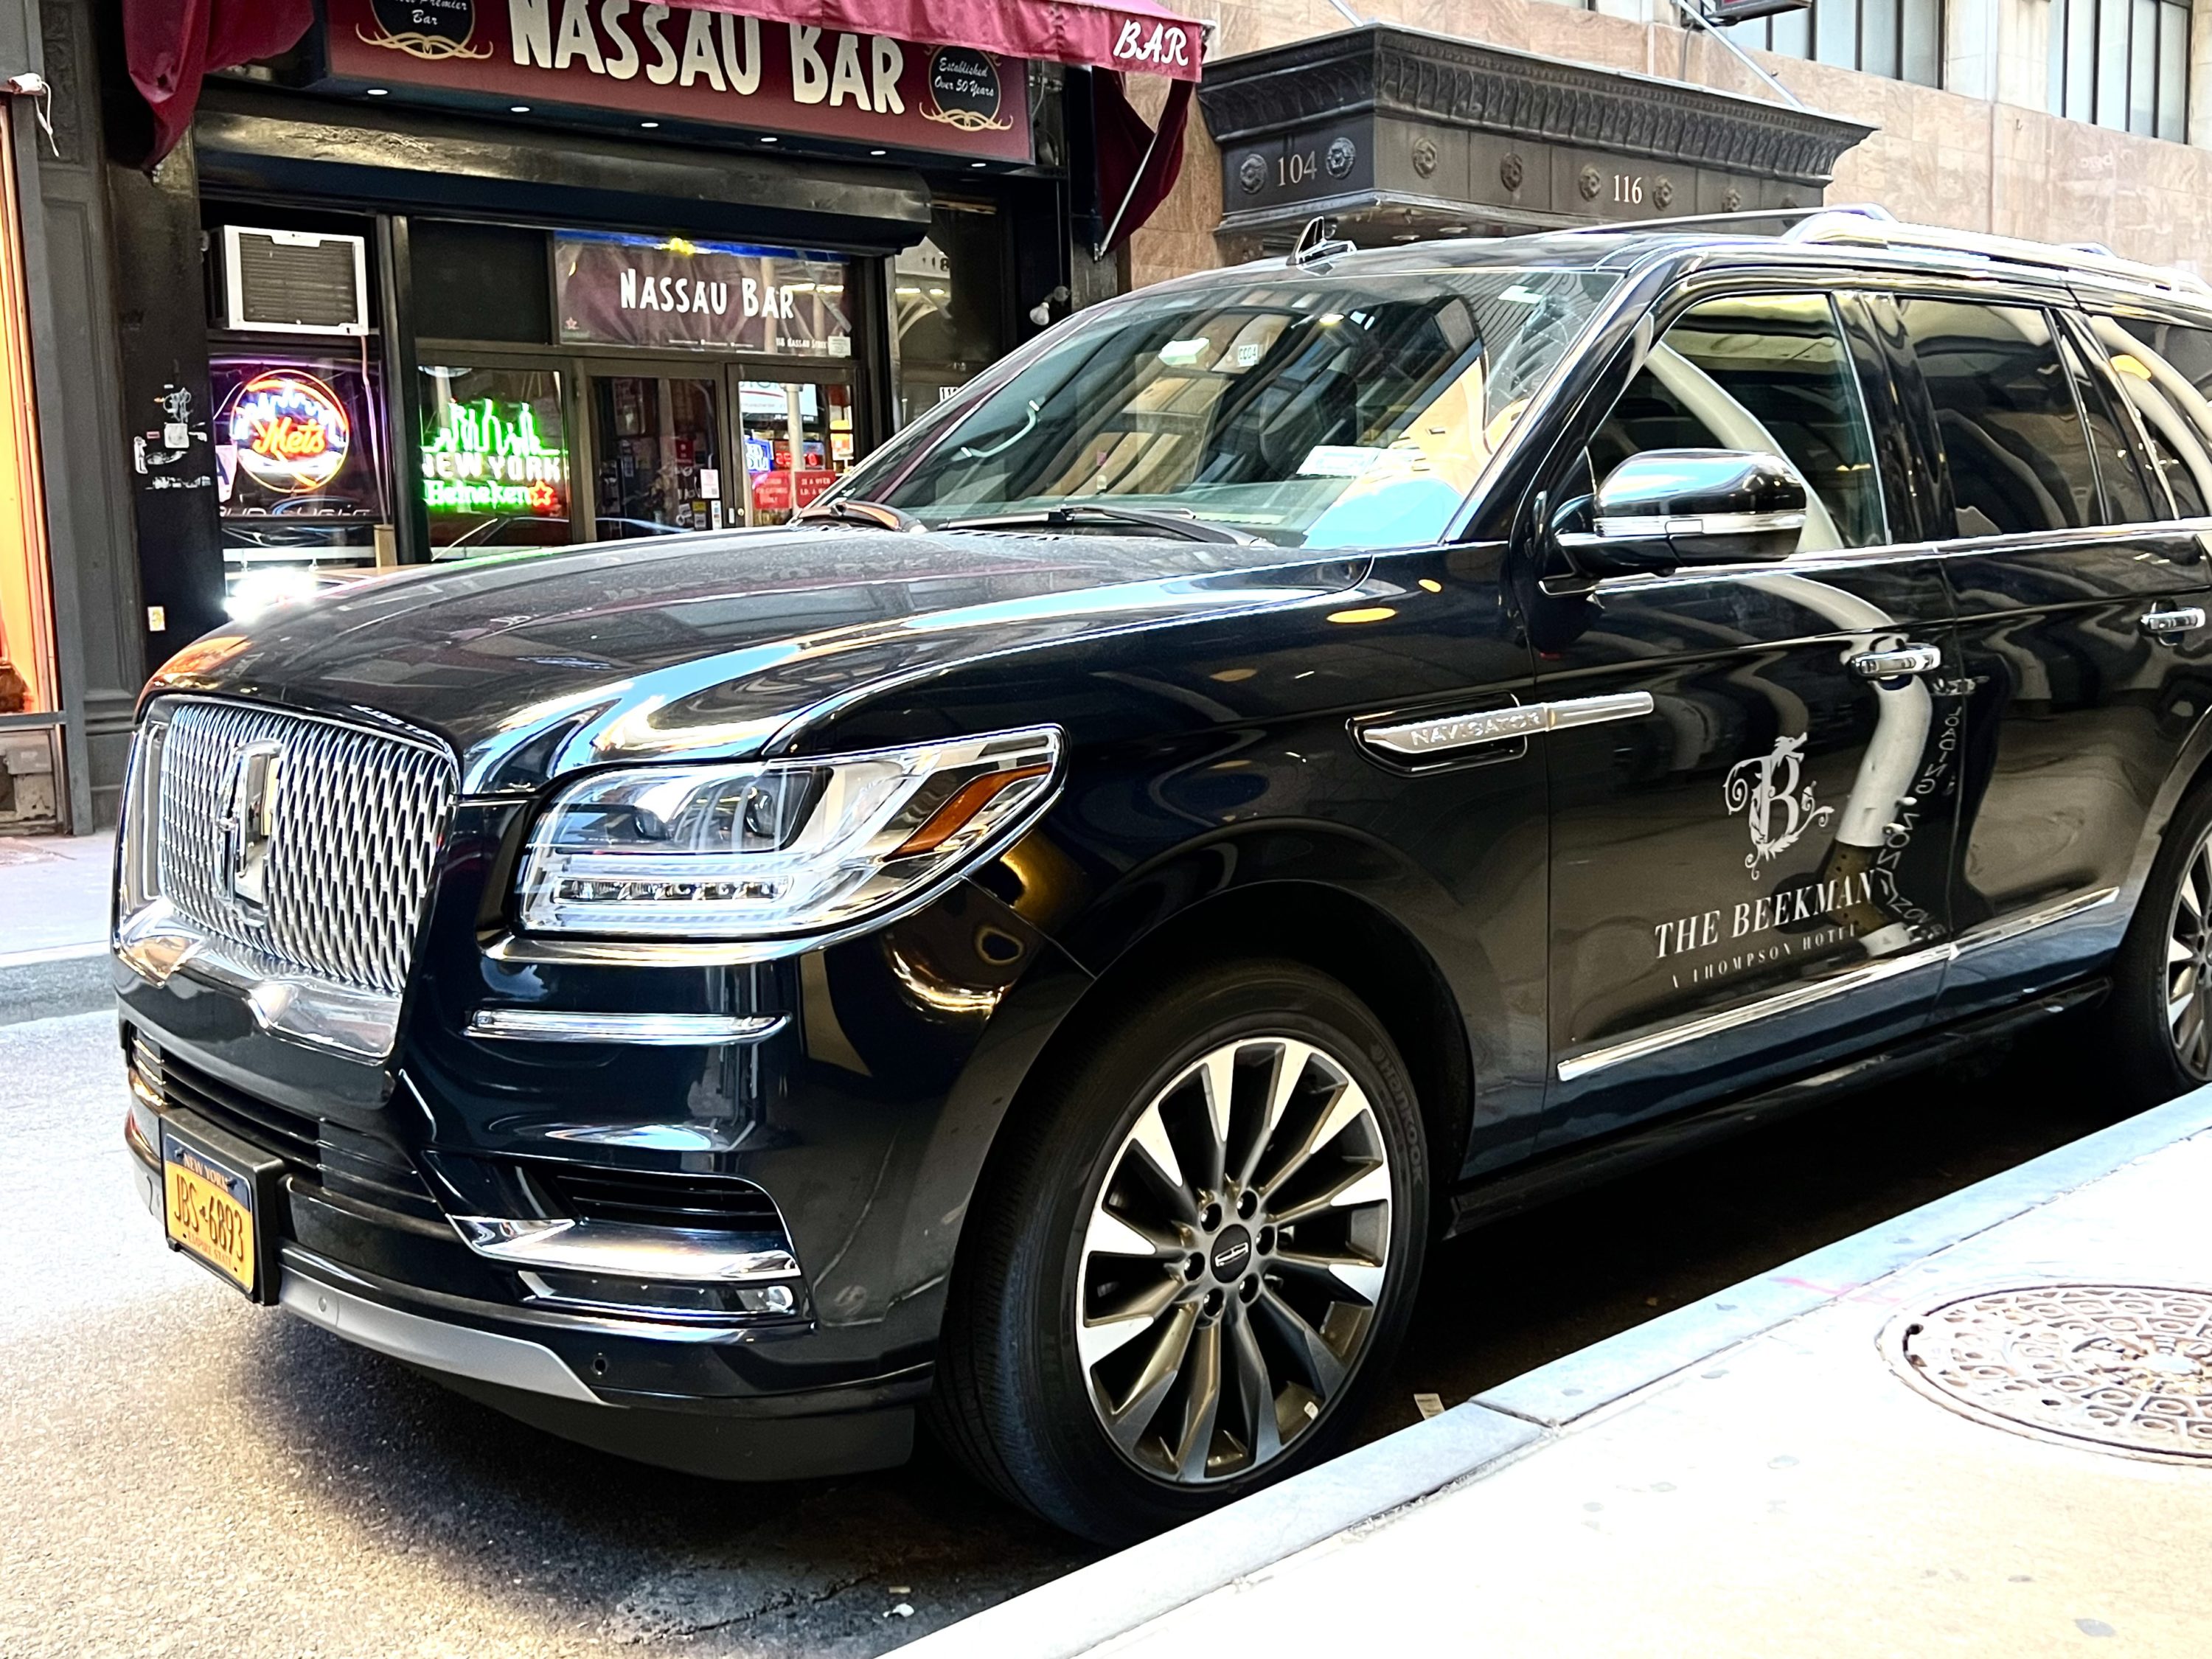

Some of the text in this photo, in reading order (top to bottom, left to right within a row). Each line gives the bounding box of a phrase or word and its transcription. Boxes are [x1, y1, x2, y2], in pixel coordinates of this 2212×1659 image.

[411, 9, 438, 25] Bar
[509, 0, 905, 114] NASSAU BAR
[1113, 18, 1189, 66] BAR
[939, 57, 989, 77] Established
[934, 75, 994, 97] Over 50 Years
[1278, 150, 1318, 186] 104
[1613, 174, 1643, 204] 116
[620, 268, 794, 319] NASSAU BAR
[252, 417, 325, 453] Mets
[487, 454, 561, 483] YORK
[422, 479, 533, 509] Heineken
[1655, 909, 1721, 959] THE
[1731, 869, 1875, 939] BEEKMAN
[1692, 942, 1792, 983] THOMPSON
[183, 1152, 204, 1178] NEW
